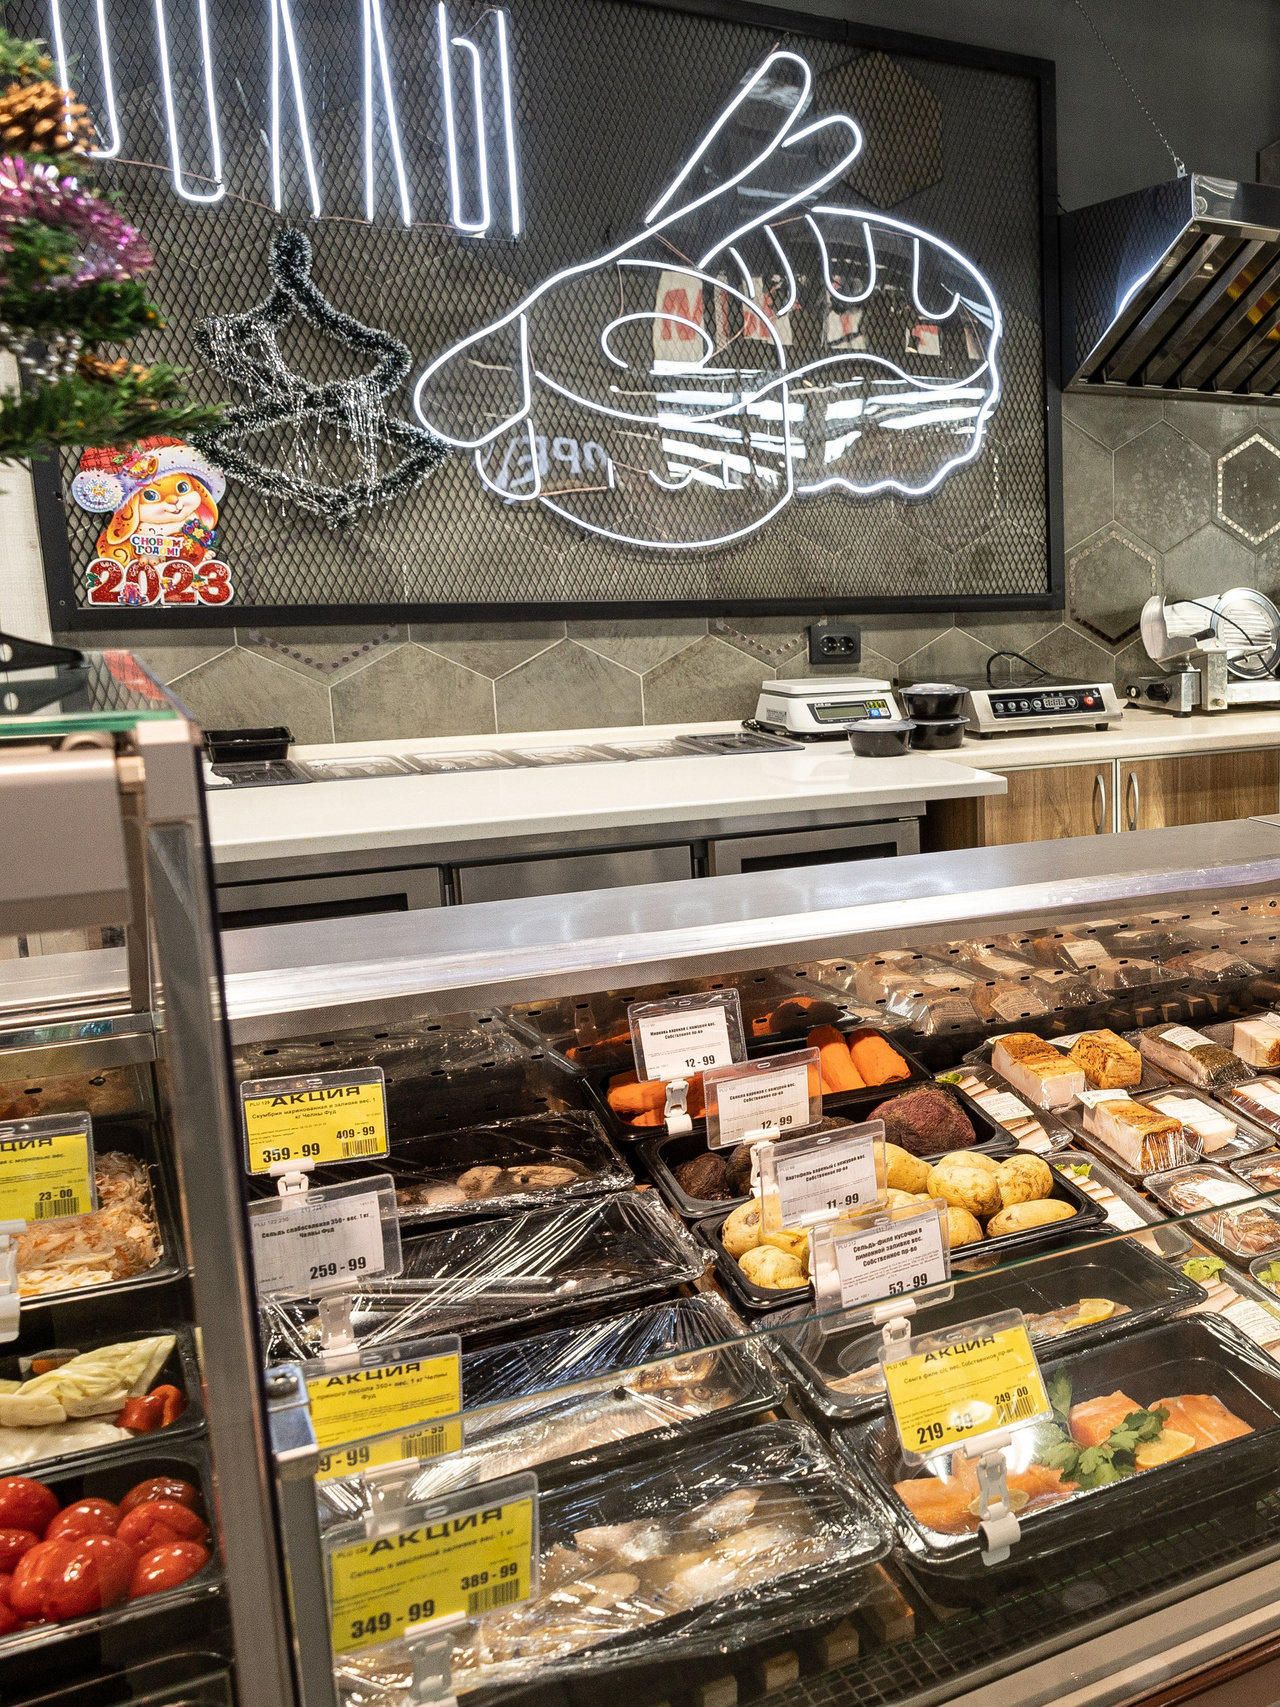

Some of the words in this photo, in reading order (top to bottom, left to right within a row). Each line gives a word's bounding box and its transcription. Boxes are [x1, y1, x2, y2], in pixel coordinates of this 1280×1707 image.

[137, 546, 179, 556] ГОДОМ!
[90, 560, 232, 604] 2023
[685, 1058, 696, 1068] 12
[702, 1054, 716, 1066] 99
[270, 1086, 361, 1108] АКЦИЯ
[252, 1110, 283, 1120] Скумбрия
[283, 1104, 328, 1116] маринованная
[334, 1100, 358, 1109] заливке
[324, 1109, 337, 1117] Фуд
[336, 1128, 355, 1140] 409
[362, 1125, 375, 1136] 99
[761, 1119, 772, 1130] 12
[779, 1115, 793, 1126] 99
[262, 1147, 291, 1163] 359
[301, 1142, 321, 1157] 99
[38, 1191, 52, 1201] 23
[59, 1188, 73, 1199] 00
[826, 1199, 837, 1210] 11
[845, 1193, 859, 1206] 99
[261, 1230, 286, 1239] Сельдь
[286, 1220, 330, 1234] слабосоленая
[321, 1227, 335, 1236] Фуд
[852, 1235, 894, 1253] Сельдь-филе
[894, 1229, 918, 1241] кусочки
[855, 1246, 885, 1262] лимонной
[885, 1240, 911, 1253] заливке
[911, 1236, 924, 1245] вес.
[862, 1251, 901, 1268] Собственное
[901, 1246, 918, 1257] пр-во
[309, 1262, 337, 1281] 259
[348, 1256, 367, 1272] 99
[888, 1280, 904, 1295] 53
[912, 1273, 928, 1287] 99
[924, 1335, 995, 1363] АКЦИЯ
[325, 1361, 421, 1388] АКЦИЯ
[903, 1375, 923, 1385] Семга
[923, 1370, 938, 1380] филе
[961, 1353, 998, 1368] Собственное
[360, 1393, 377, 1401] Фуд
[994, 1391, 1012, 1406] 249
[1016, 1386, 1029, 1399] 00
[917, 1422, 944, 1445] 219
[346, 1445, 371, 1468] 99
[369, 1506, 503, 1556] АКЦИЯ
[460, 1571, 489, 1591] 389
[499, 1562, 519, 1579] 99
[350, 1612, 392, 1640] 349
[408, 1599, 436, 1623] 99
